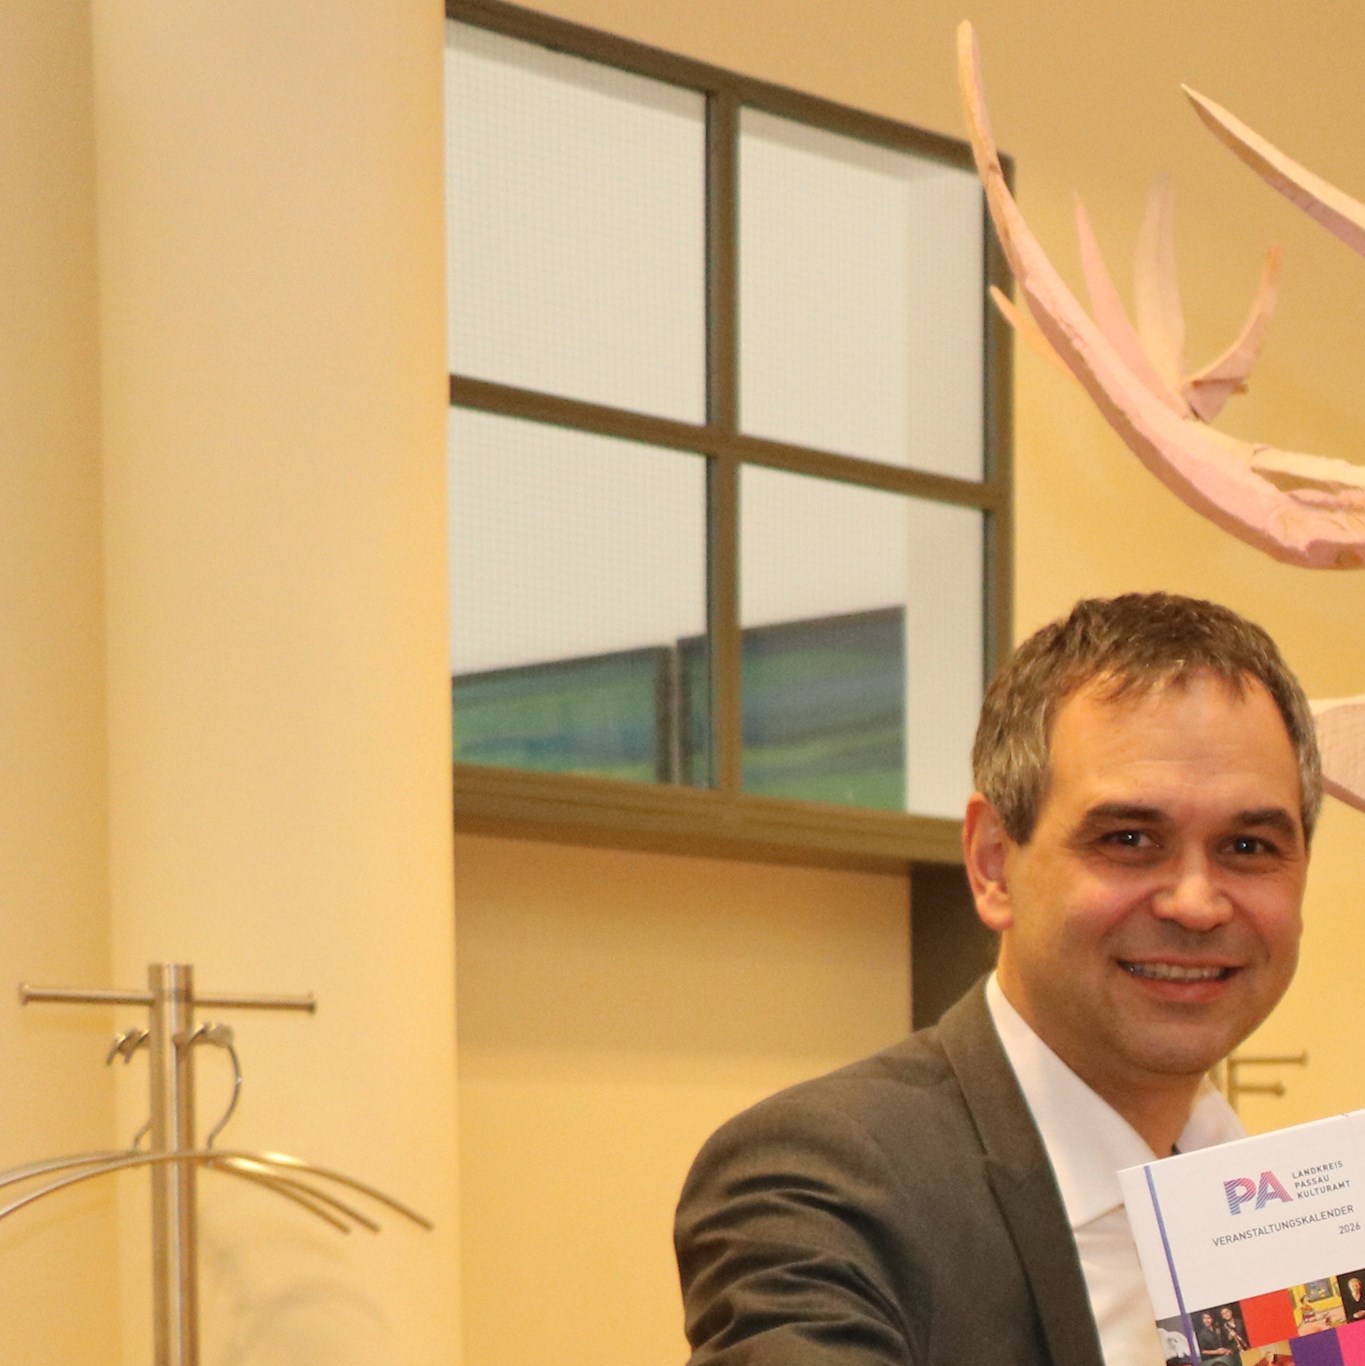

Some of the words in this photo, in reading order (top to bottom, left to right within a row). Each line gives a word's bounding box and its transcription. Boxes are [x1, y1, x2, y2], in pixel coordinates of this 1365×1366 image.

[1291, 1160, 1344, 1179] LANDKREIS
[1294, 1174, 1330, 1189] PASSAU
[1297, 1179, 1351, 1199] KULTURAMT
[1222, 1169, 1294, 1216] PA
[1211, 1204, 1355, 1247] VERANSTALTUNGSKALENDER
[1338, 1222, 1361, 1235] 2026
